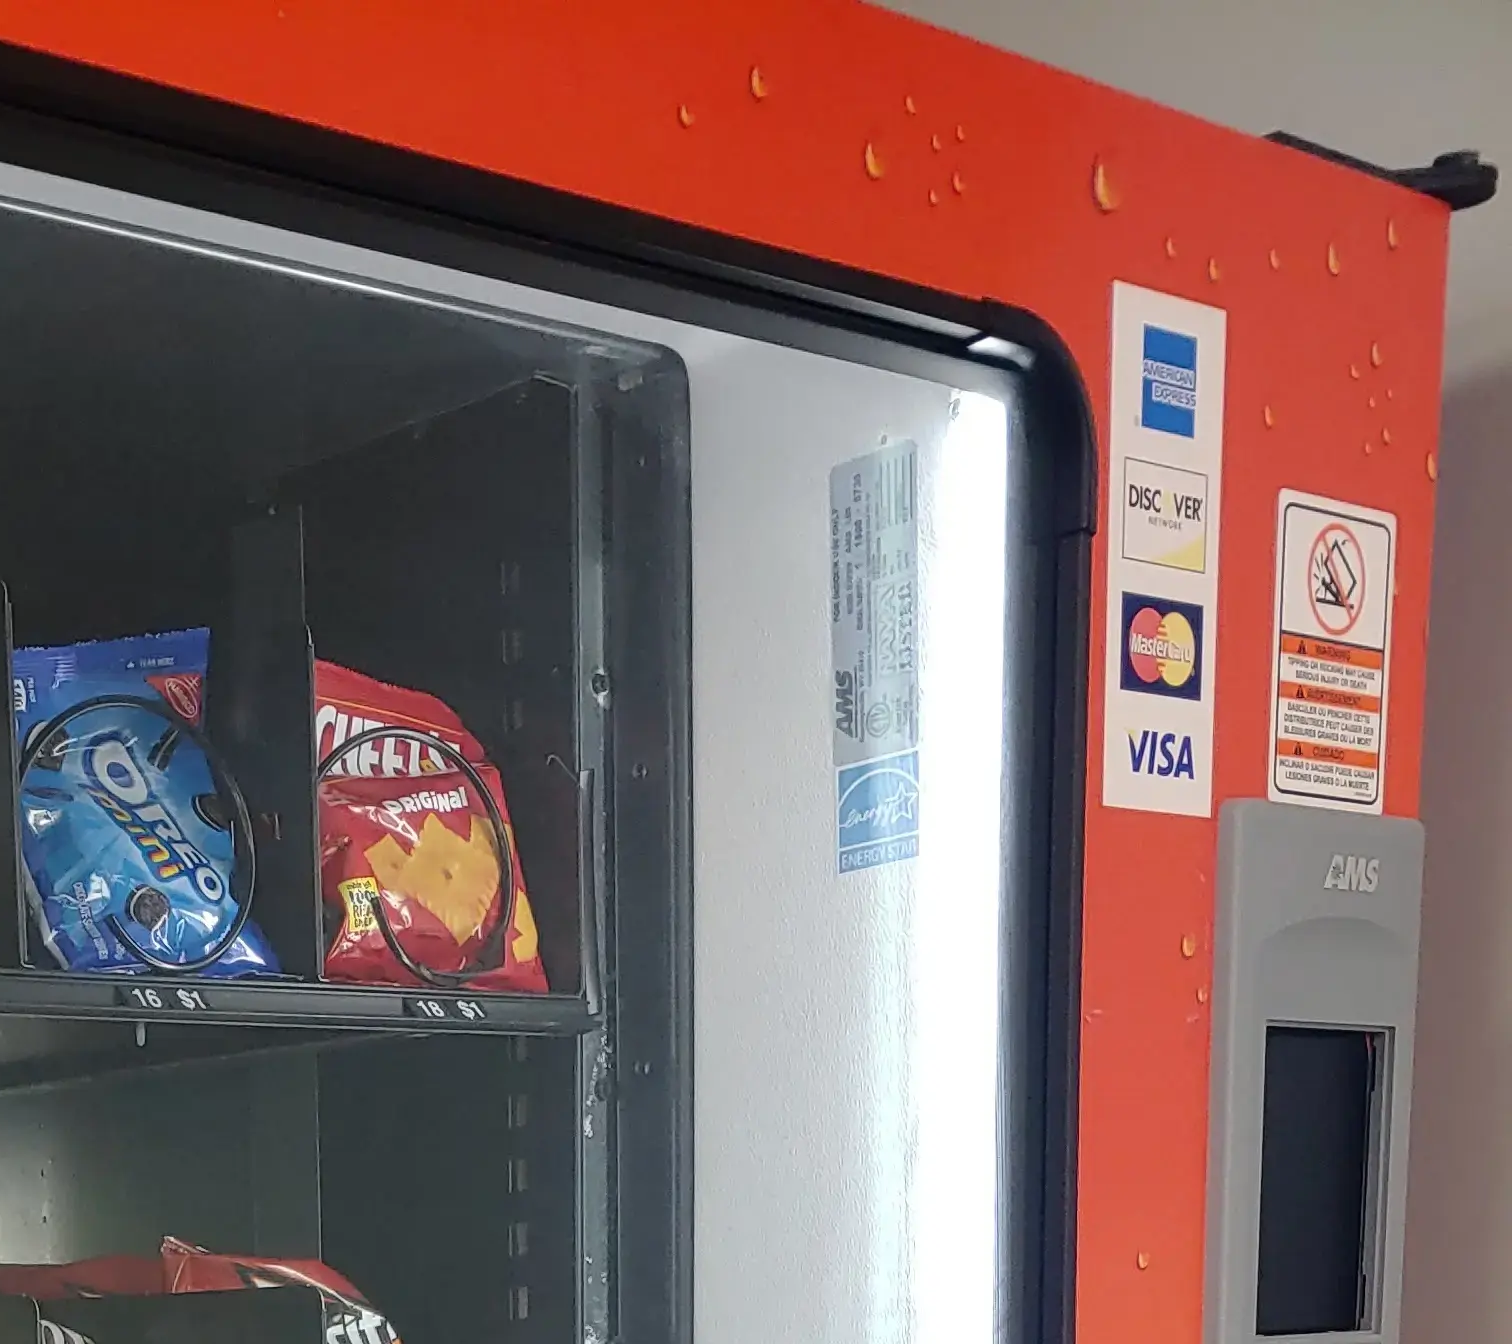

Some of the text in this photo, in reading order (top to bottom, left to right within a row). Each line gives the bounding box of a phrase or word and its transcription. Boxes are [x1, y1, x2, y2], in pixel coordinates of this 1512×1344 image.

[1143, 361, 1194, 386] AMERICAN
[1154, 383, 1197, 407] EXPRESS
[1148, 516, 1182, 531] NETWORK
[834, 669, 853, 736] AMS
[1126, 727, 1195, 780] VISA
[90, 736, 228, 903] OREO
[840, 842, 886, 868] ENERGY
[1323, 854, 1380, 893] AMS
[130, 987, 207, 1011] 16 $1
[416, 999, 486, 1020] 18 $1
